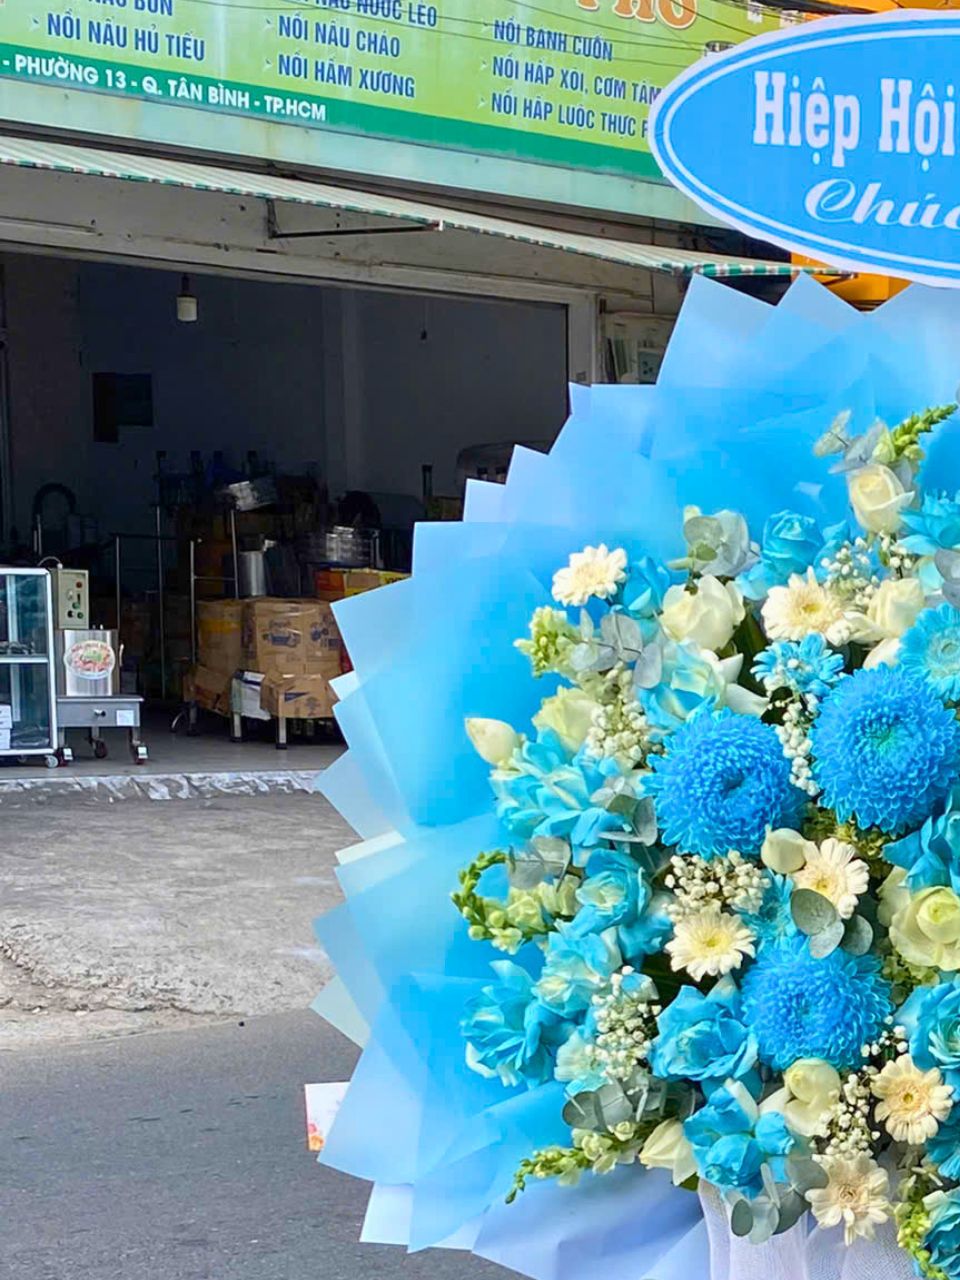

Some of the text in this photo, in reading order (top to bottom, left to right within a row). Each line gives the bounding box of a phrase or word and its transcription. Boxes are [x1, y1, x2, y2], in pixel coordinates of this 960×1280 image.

[134, 23, 159, 54] HỦ
[15, 54, 99, 84] PHƯỜNG
[105, 69, 126, 89] 13
[142, 76, 162, 95] Q.
[168, 77, 203, 101] TÂN
[208, 86, 250, 109] BÌNH
[263, 95, 326, 121] TP.HCM
[752, 71, 861, 168] Hiệp
[878, 78, 956, 171] Hội
